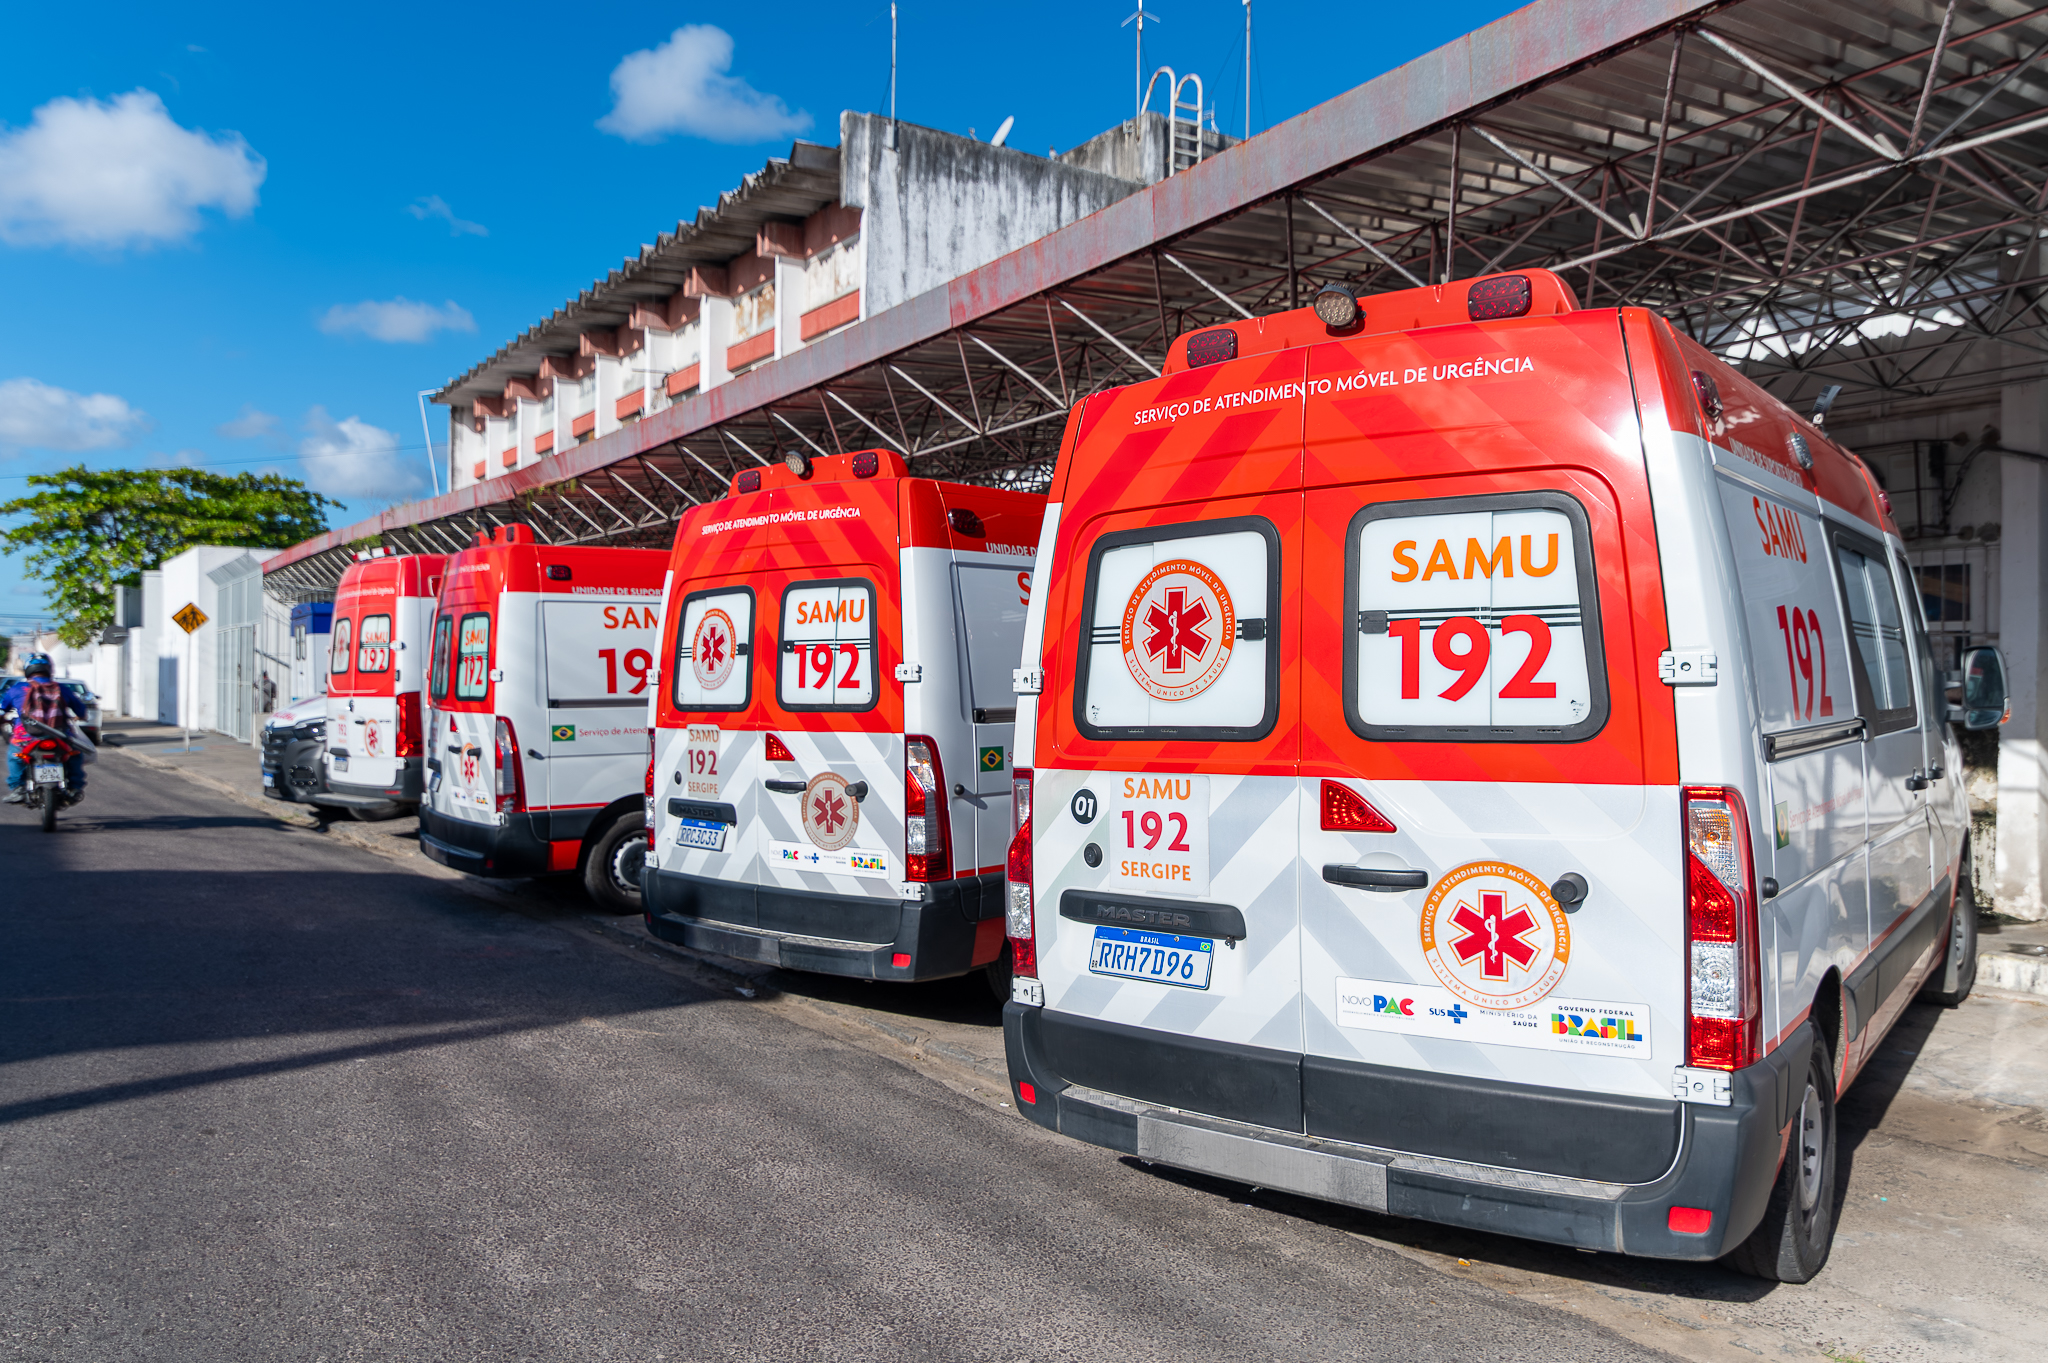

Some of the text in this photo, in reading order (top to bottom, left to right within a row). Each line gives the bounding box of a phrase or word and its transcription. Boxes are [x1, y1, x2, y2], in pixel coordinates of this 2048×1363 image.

[1133, 356, 1535, 426] SERVIÇO DE ATENDIMENTO MÓVEL DE URGÊNCIA
[701, 506, 861, 536] SERVIÇO DE ATENDIMENTO MÓVEL DE URGÊNCIA
[1752, 495, 1808, 564] SAMU
[985, 542, 1030, 557] UNIDADE
[1391, 533, 1559, 583] SAMU
[796, 598, 865, 625] SAMU
[1124, 607, 1134, 645] SERVIÇO
[1132, 594, 1140, 605] DE
[1188, 565, 1213, 583] MÓVEL
[1213, 582, 1222, 593] DE
[1219, 594, 1232, 641] URGÊNCIA
[365, 631, 388, 644] SAMU
[465, 629, 487, 646] SAMU
[364, 647, 386, 671] 192
[464, 654, 484, 686] 192
[794, 643, 861, 690] 192
[1388, 614, 1557, 702] 192
[1776, 604, 1834, 722] 192
[1156, 687, 1185, 697] ÚNICO
[1189, 684, 1200, 693] DE
[1203, 656, 1225, 684] SAÚDE
[579, 728, 610, 738] Serviço
[611, 726, 622, 736] de
[689, 729, 720, 743] SAMU
[688, 749, 718, 776] 192
[688, 781, 719, 794] SERGIPE
[1123, 777, 1191, 801] SAMU
[1075, 796, 1095, 818] 01
[1121, 810, 1190, 852] 192
[783, 849, 799, 861] PAC
[851, 856, 886, 871] BRASIL
[1121, 860, 1191, 882] SERGIPE
[1097, 904, 1192, 928] MASTER
[1424, 865, 1567, 954] SERVIÇO DE ATENDIMENTO MÓVEL DE URGÊNCIA
[1139, 935, 1160, 945] BRASIL
[1098, 942, 1195, 979] RRH7D96
[1431, 958, 1559, 1006] SISTEMA ÚNICO DE SAÚDE
[1342, 994, 1415, 1016] NOVO PAC
[1429, 1007, 1446, 1017] SUS
[1558, 1005, 1634, 1017] GOVERNO FEDERAL
[1512, 1020, 1538, 1028] SAÚDE
[1551, 1013, 1643, 1042] BRASIL
